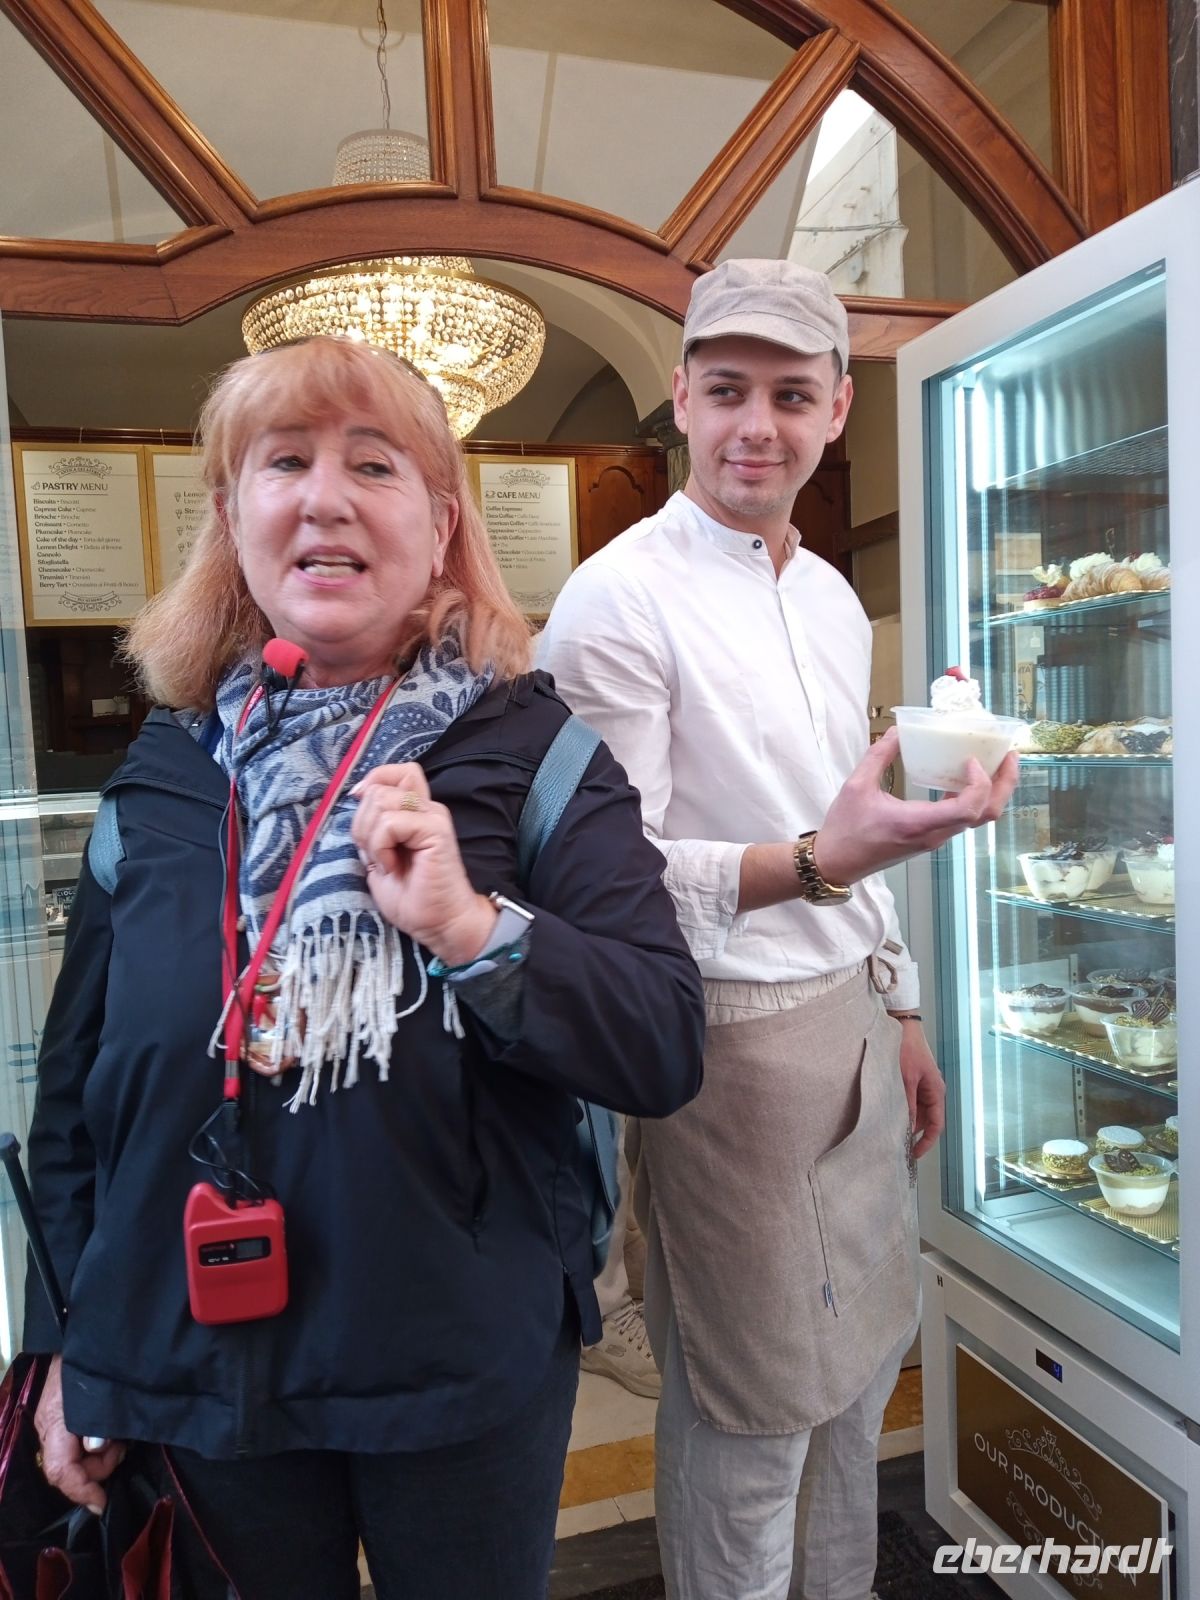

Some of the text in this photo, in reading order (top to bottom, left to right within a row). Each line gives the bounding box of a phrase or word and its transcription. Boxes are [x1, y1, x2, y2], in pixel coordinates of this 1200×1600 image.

[42, 482, 108, 491] PASTRY MENU
[497, 491, 517, 499] CAFE
[974, 1432, 1136, 1587] OUR PRODUCTION
